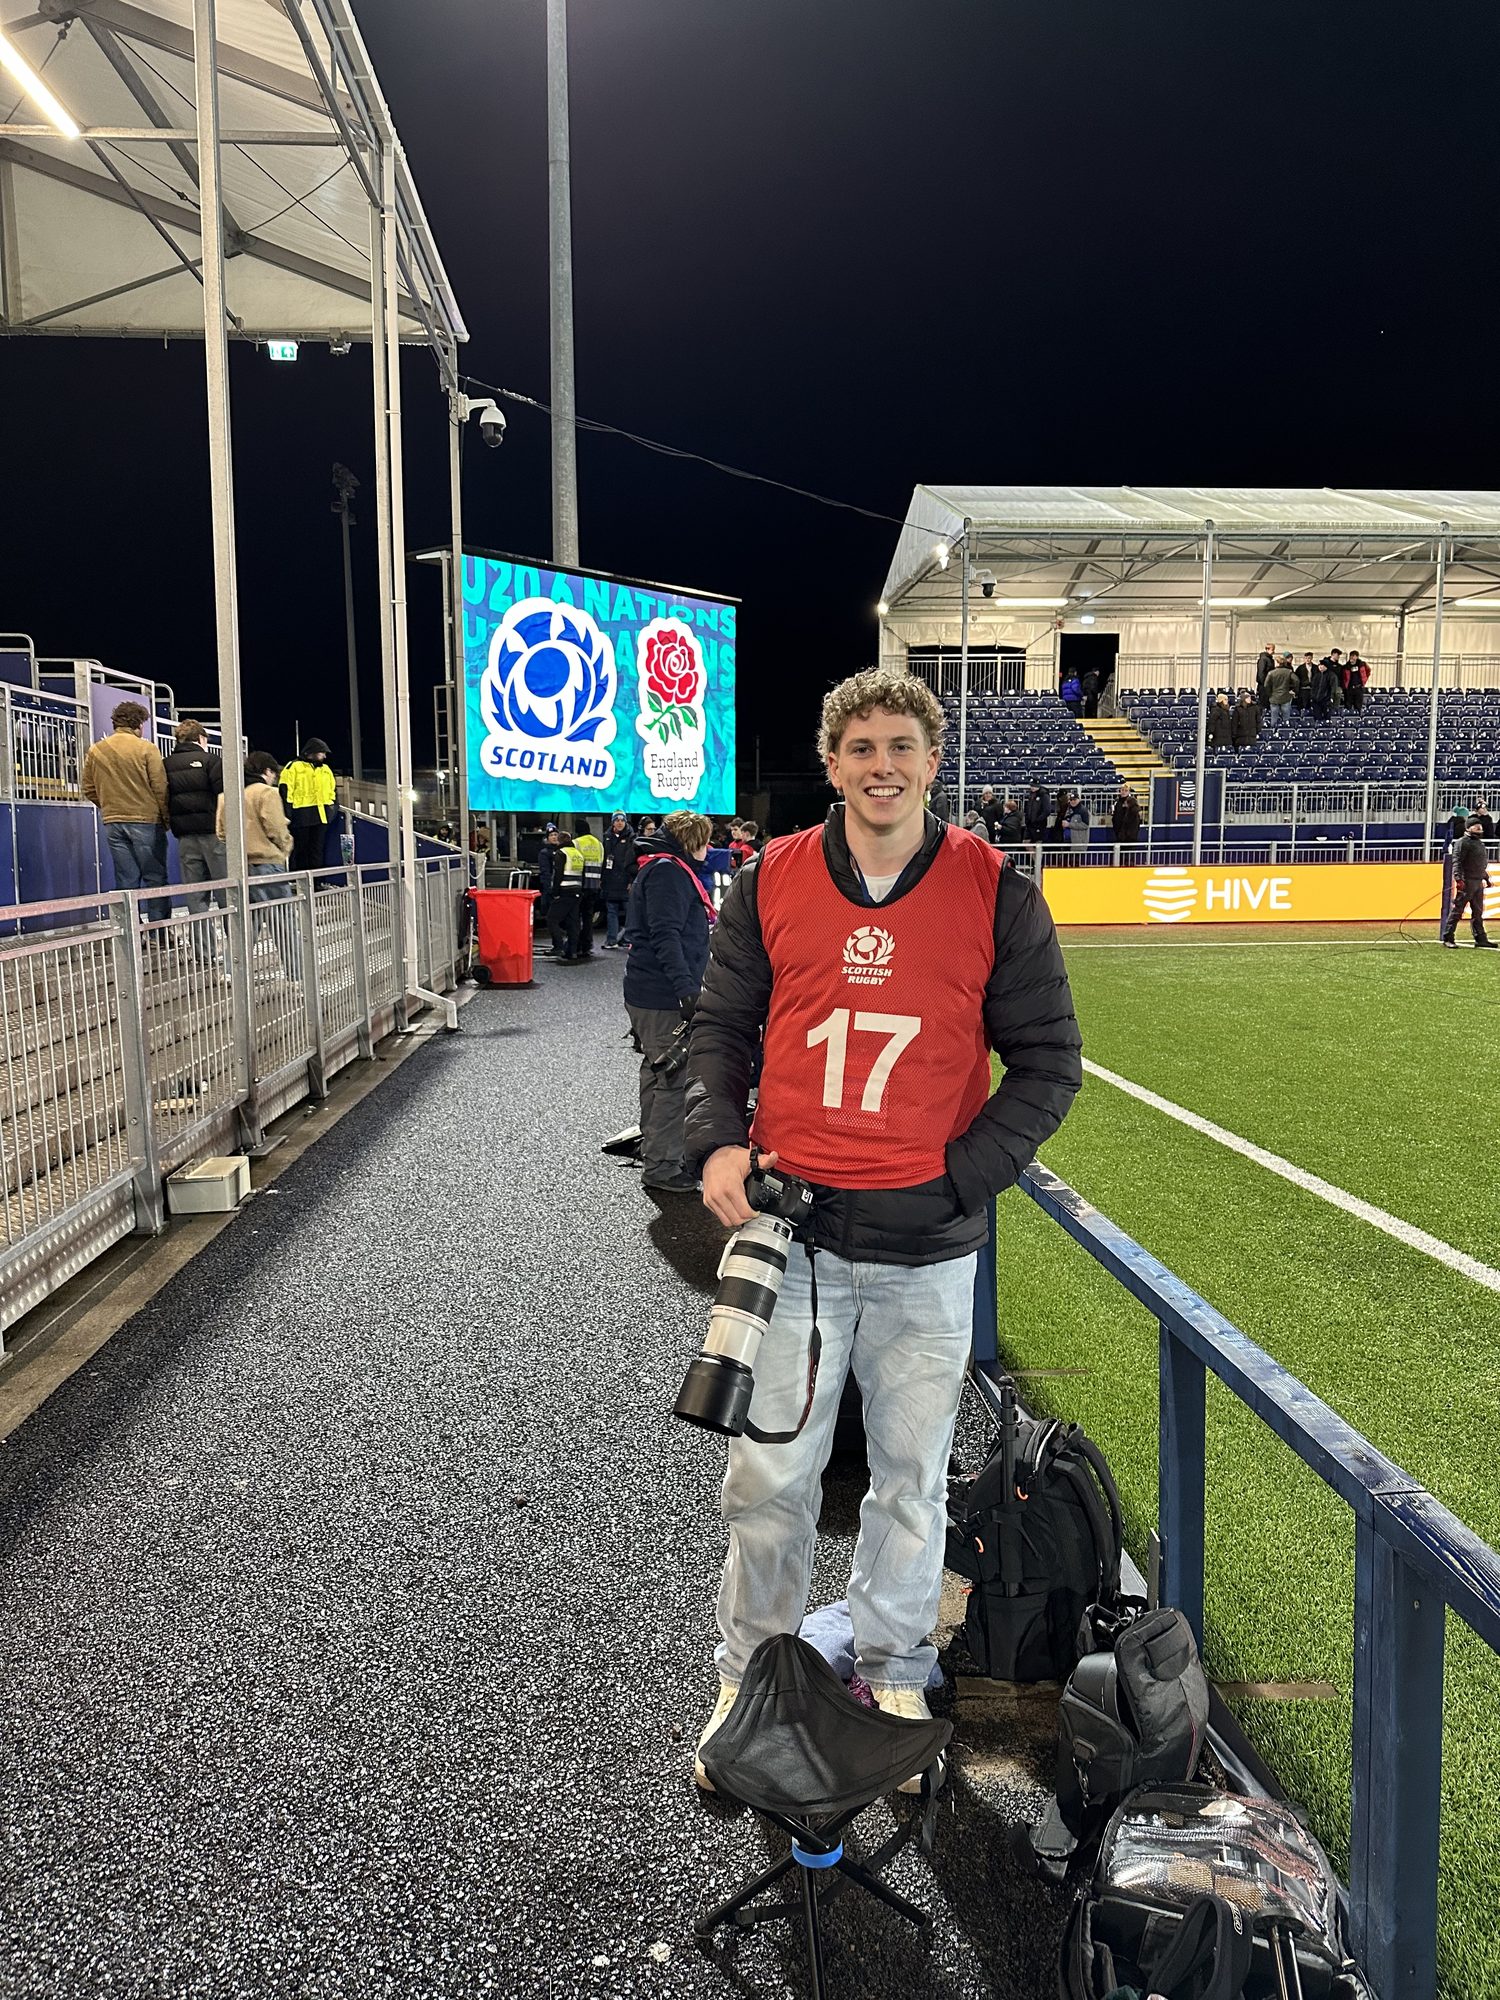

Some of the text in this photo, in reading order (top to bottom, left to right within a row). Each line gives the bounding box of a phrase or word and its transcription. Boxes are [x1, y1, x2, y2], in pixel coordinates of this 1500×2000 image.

[462, 555, 541, 614] U20
[584, 577, 736, 639] NATIONS
[490, 746, 607, 778] SCOTLAND
[651, 752, 698, 771] England
[657, 772, 694, 791] Rugby
[1206, 877, 1292, 910] HIVE
[841, 966, 892, 977] SCOTTISH
[848, 976, 886, 986] RUGBY
[806, 1007, 922, 1113] 17
